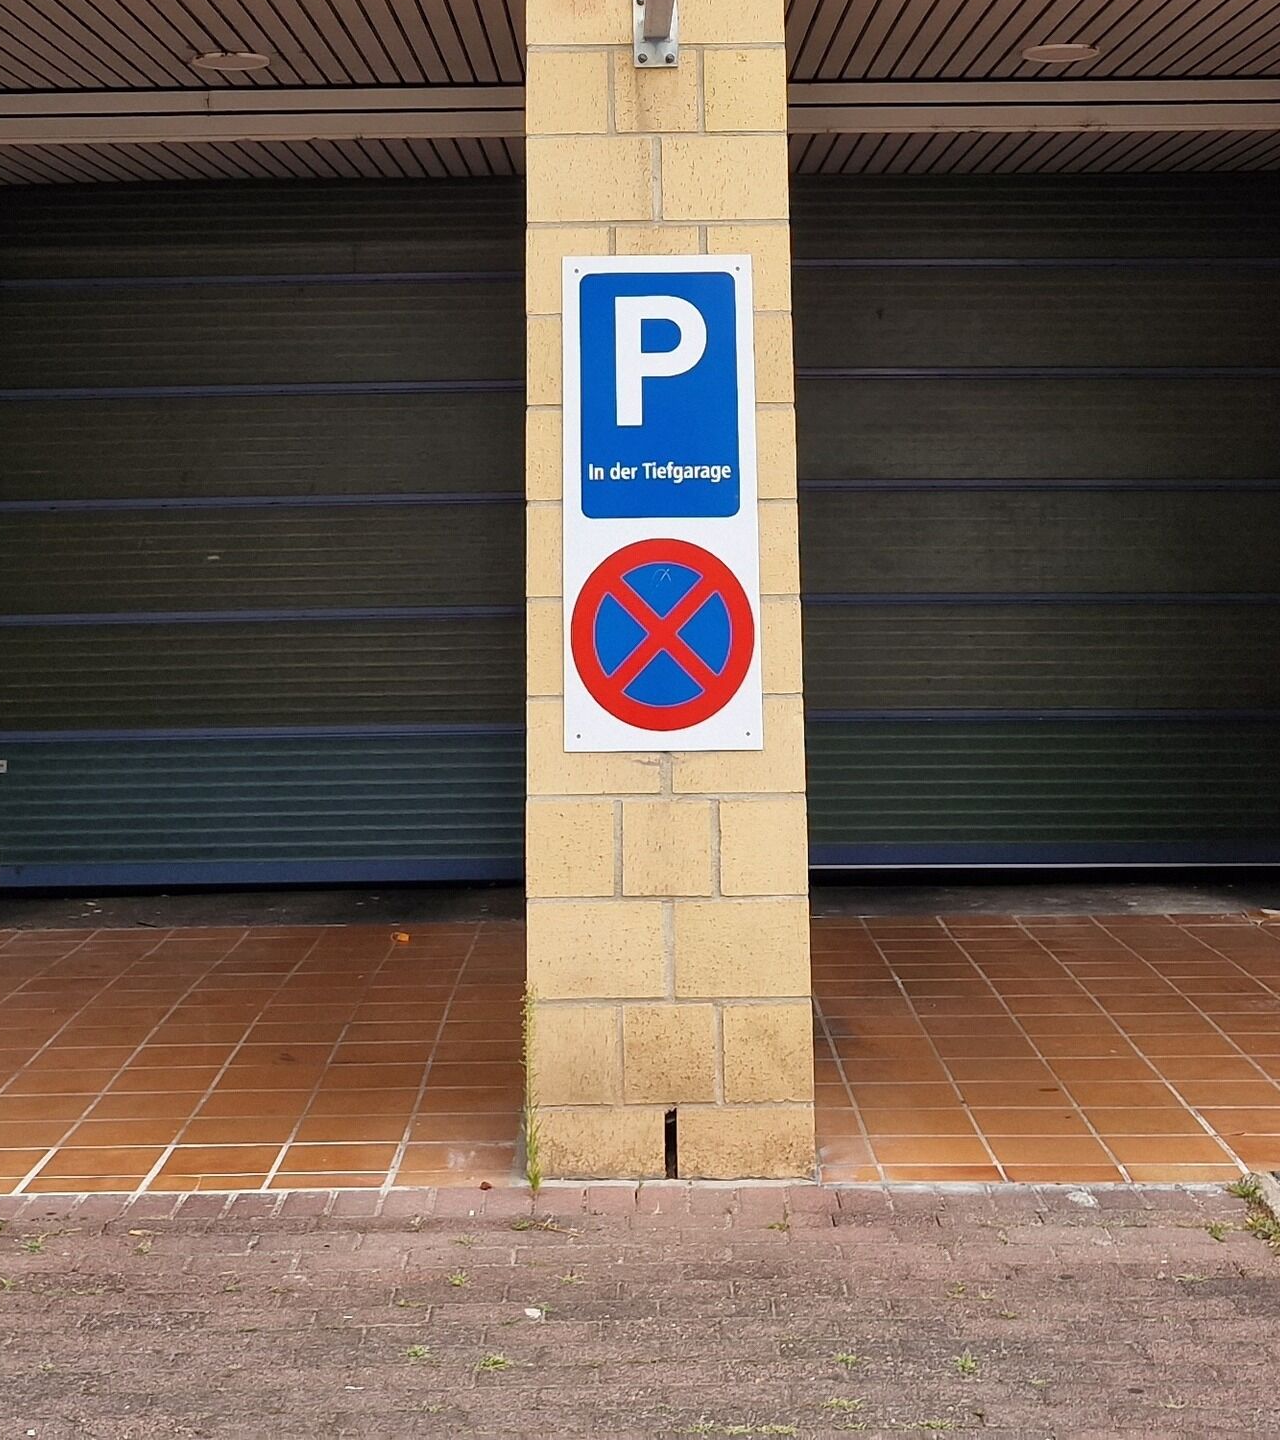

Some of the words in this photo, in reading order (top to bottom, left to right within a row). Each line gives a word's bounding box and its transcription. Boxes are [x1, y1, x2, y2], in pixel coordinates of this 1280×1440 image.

[614, 295, 708, 427] P
[588, 463, 605, 481] In
[609, 462, 638, 481] der
[641, 461, 732, 484] Tiefgarage
